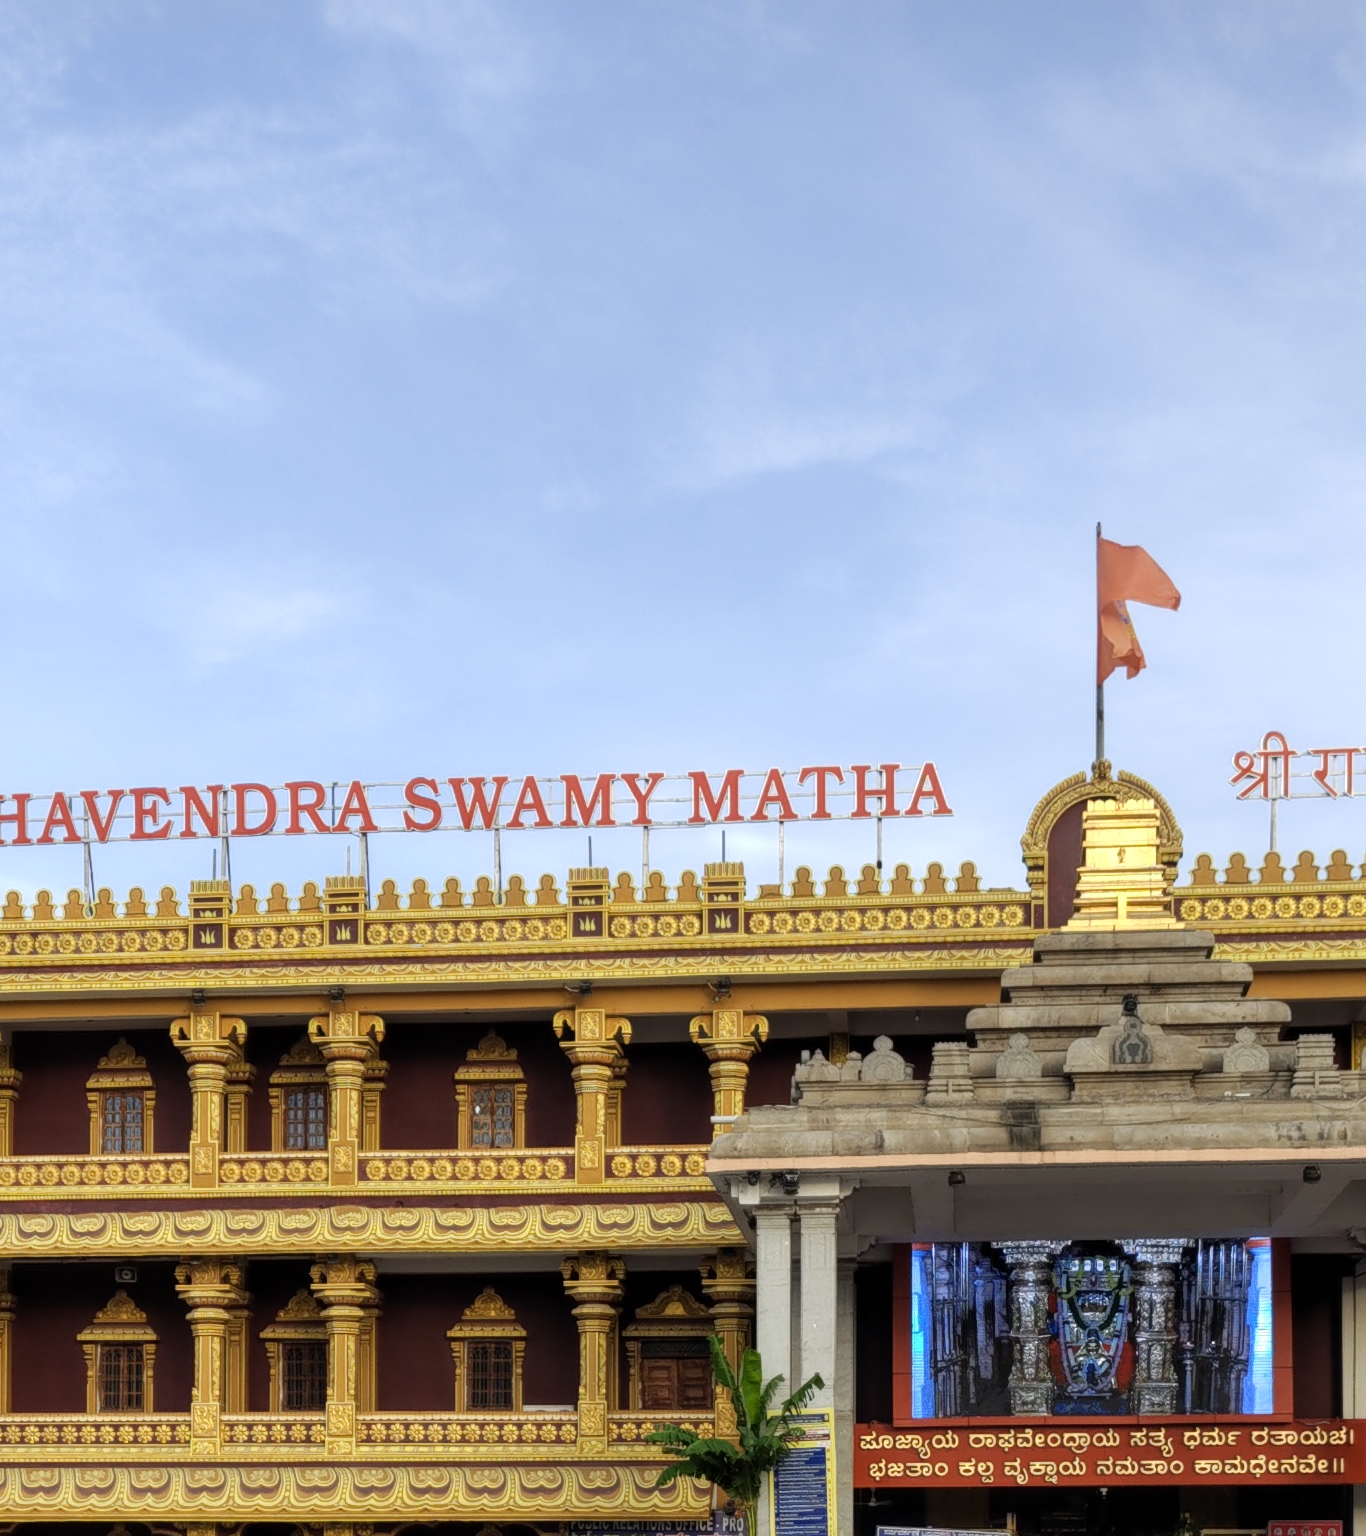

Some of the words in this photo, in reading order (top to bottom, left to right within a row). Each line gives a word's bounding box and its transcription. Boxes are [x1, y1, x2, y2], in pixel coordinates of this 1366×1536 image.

[402, 772, 665, 832] SWAMY
[688, 761, 953, 825] MATHA
[1130, 1428, 1174, 1457] ಸತ್ಯ
[675, 1518, 714, 1532] OFFICE
[722, 1517, 744, 1532] PRO
